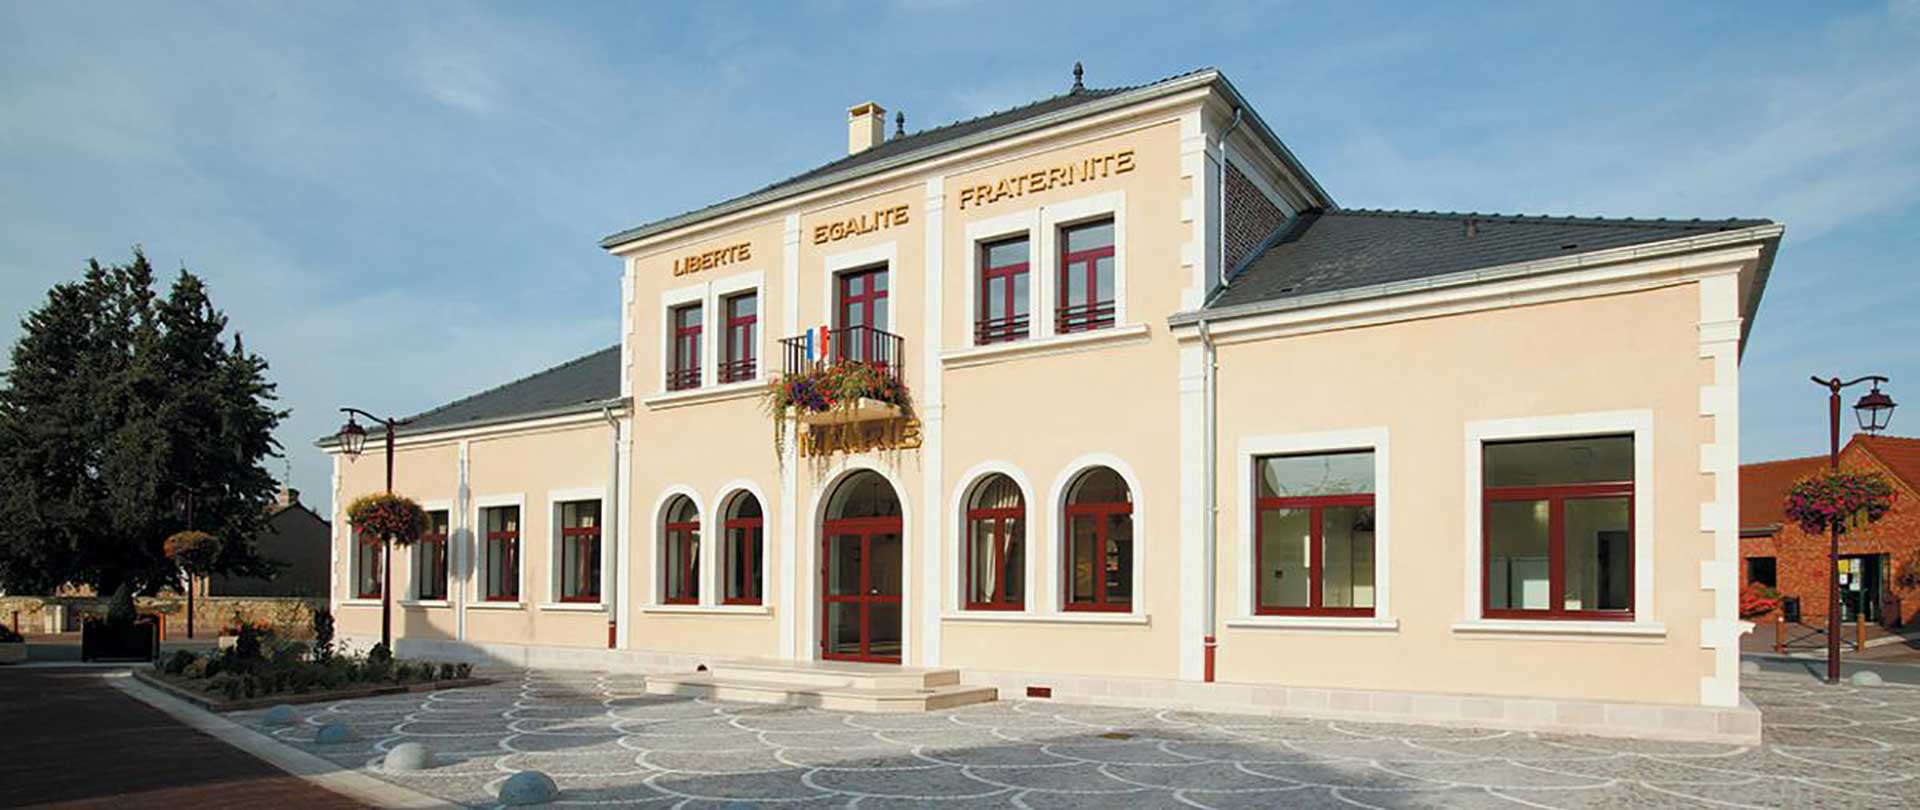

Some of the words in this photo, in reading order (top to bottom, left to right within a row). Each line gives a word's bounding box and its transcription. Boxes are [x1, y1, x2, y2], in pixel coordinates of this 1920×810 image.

[960, 150, 1136, 210] FRATERNITE
[813, 204, 909, 245] EGALITE
[672, 242, 751, 276] LIBERTE
